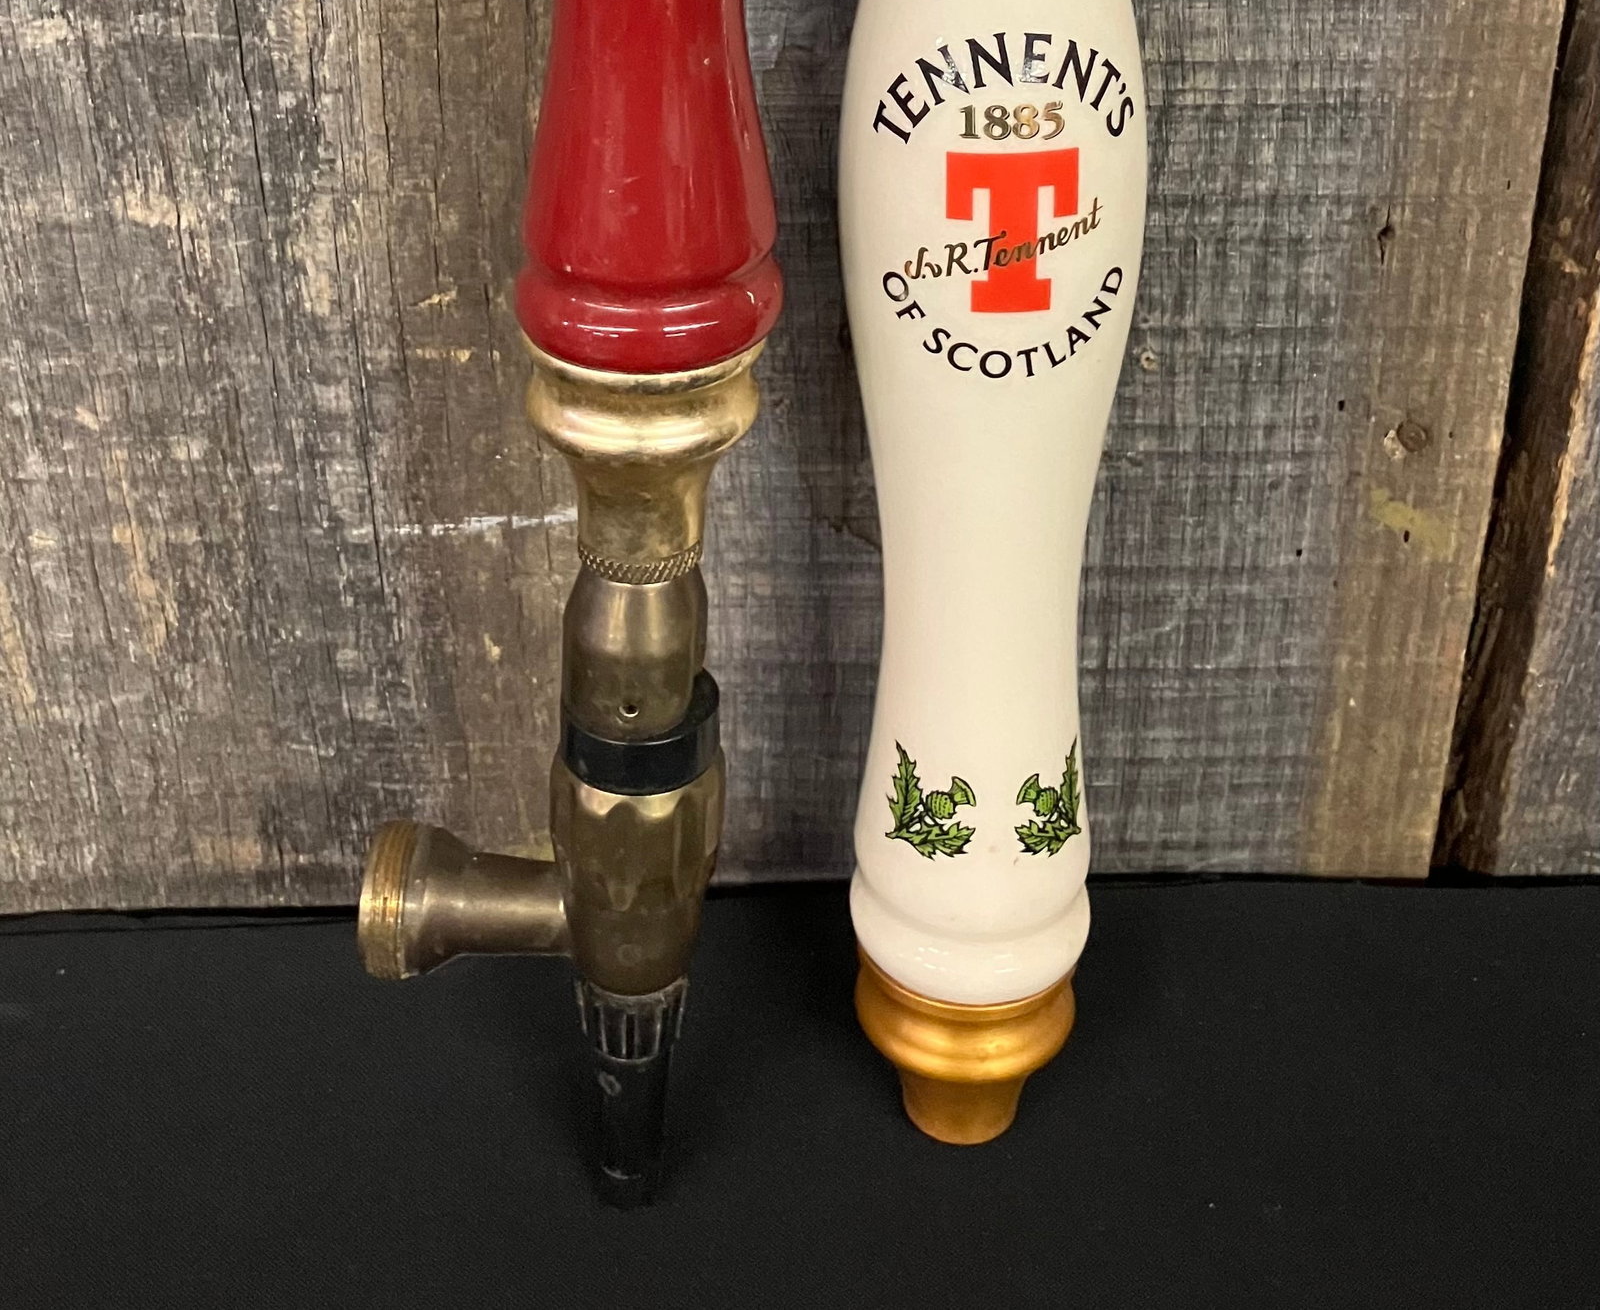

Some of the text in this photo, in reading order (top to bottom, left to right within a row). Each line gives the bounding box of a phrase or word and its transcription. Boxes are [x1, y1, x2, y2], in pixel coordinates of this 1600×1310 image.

[872, 32, 1135, 144] TENNENT'S
[957, 99, 1066, 141] 1885
[945, 147, 1080, 314] T
[881, 266, 1124, 379] OF SCOTLAND
